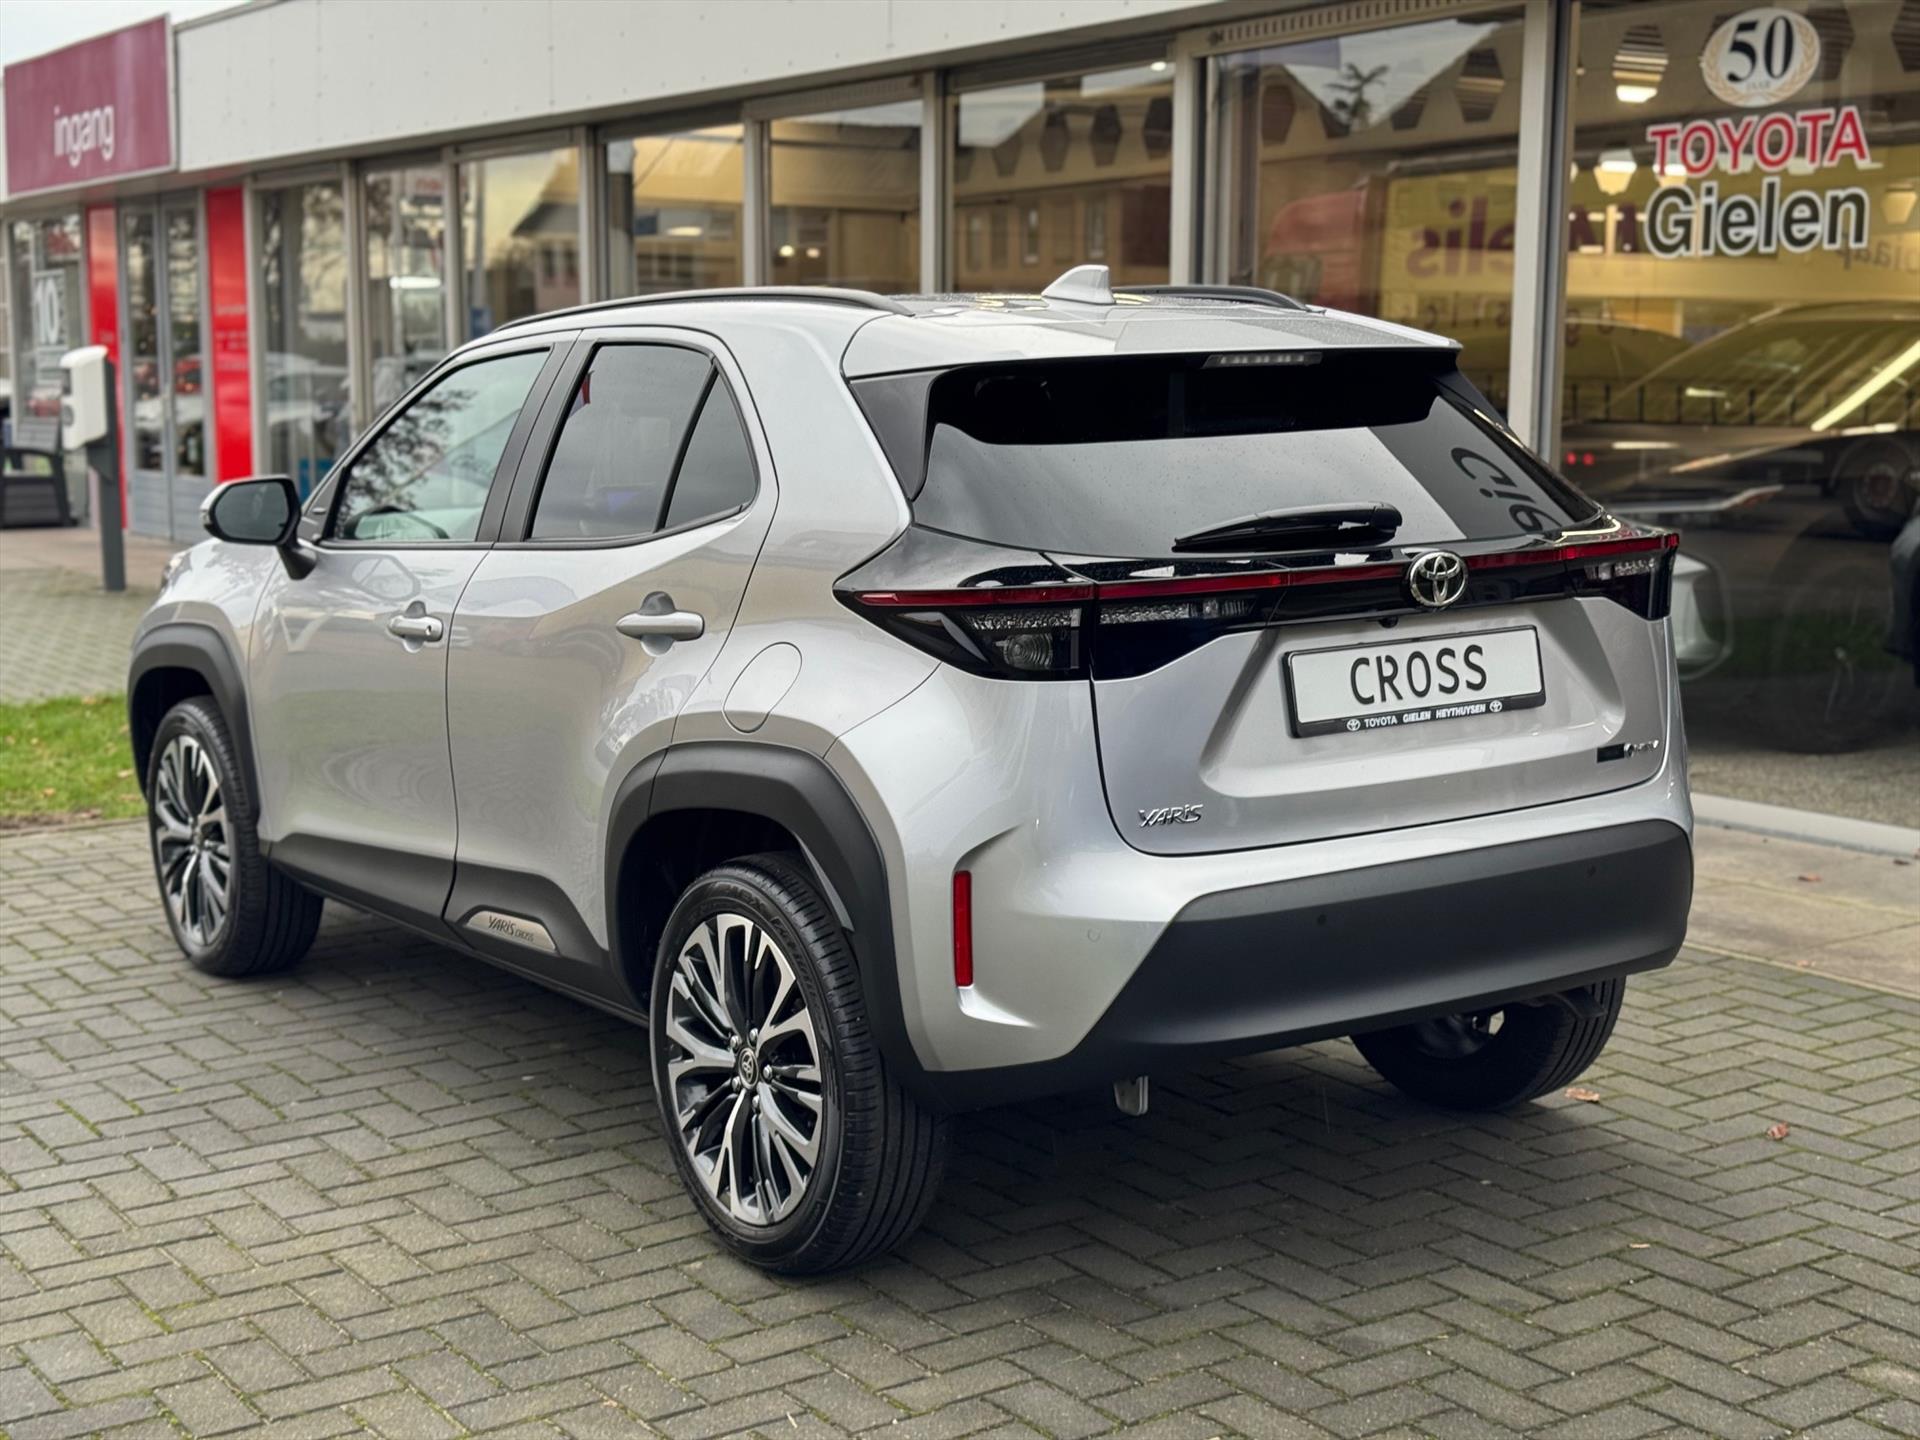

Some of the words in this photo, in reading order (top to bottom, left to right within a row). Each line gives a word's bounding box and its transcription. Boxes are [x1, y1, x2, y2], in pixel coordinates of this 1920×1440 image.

[1727, 16, 1794, 82] 50
[54, 105, 114, 167] ingang
[1647, 106, 1871, 178] TOYOTA
[1646, 178, 1869, 258] Gielen
[1350, 644, 1487, 705] CROSS
[1364, 715, 1398, 728] TOYOTA
[1402, 710, 1431, 723] GIELEN
[1435, 703, 1486, 719] HEYTHUYSEN
